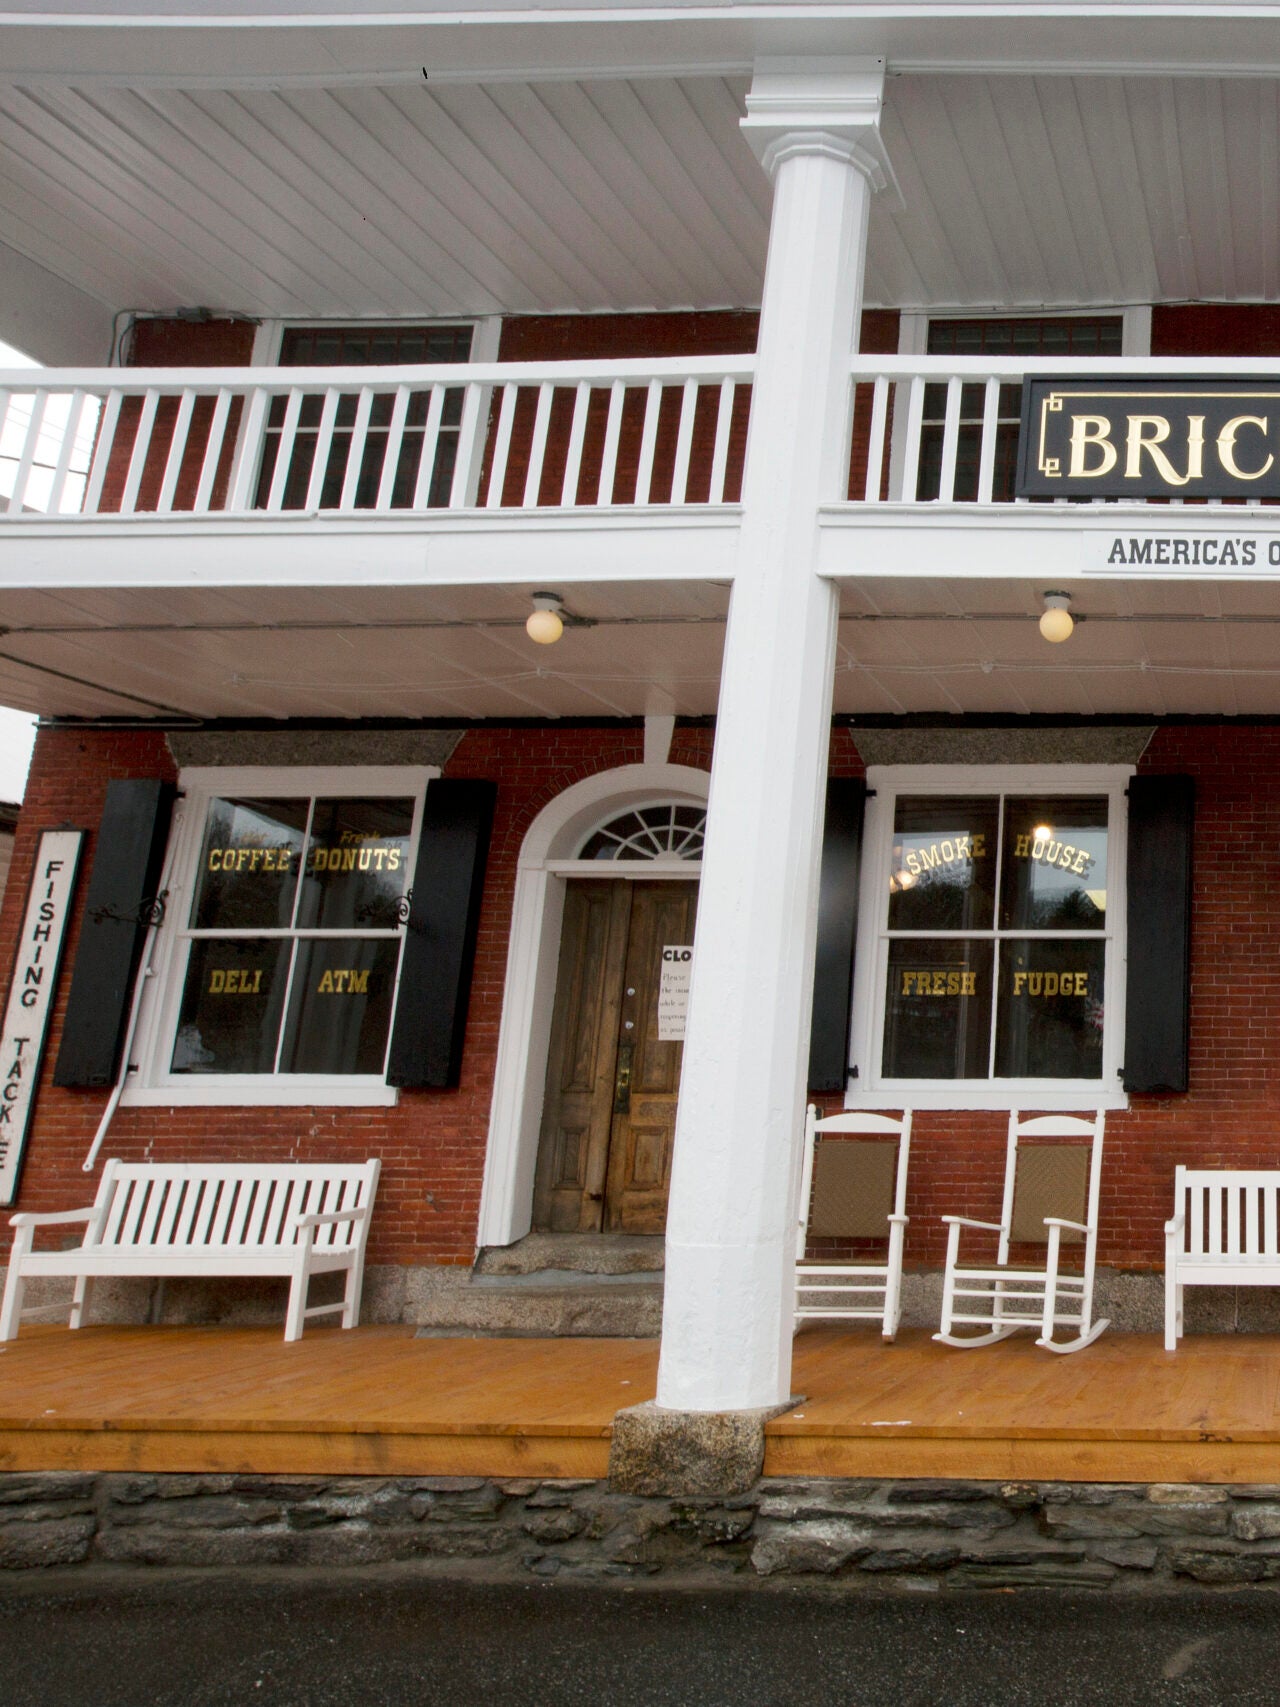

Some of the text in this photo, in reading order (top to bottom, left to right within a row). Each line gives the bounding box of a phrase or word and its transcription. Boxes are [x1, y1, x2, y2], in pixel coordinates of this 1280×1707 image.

[1108, 538, 1257, 567] AMERICA'S
[208, 848, 292, 871] COFFEE
[314, 848, 401, 871] DONUTS
[905, 834, 1090, 875] SMOKE HOUSE
[20, 860, 65, 1008] FISHING
[208, 970, 263, 994] DELI
[317, 970, 371, 994] ATM
[901, 971, 1089, 996] FRESH FUDGE
